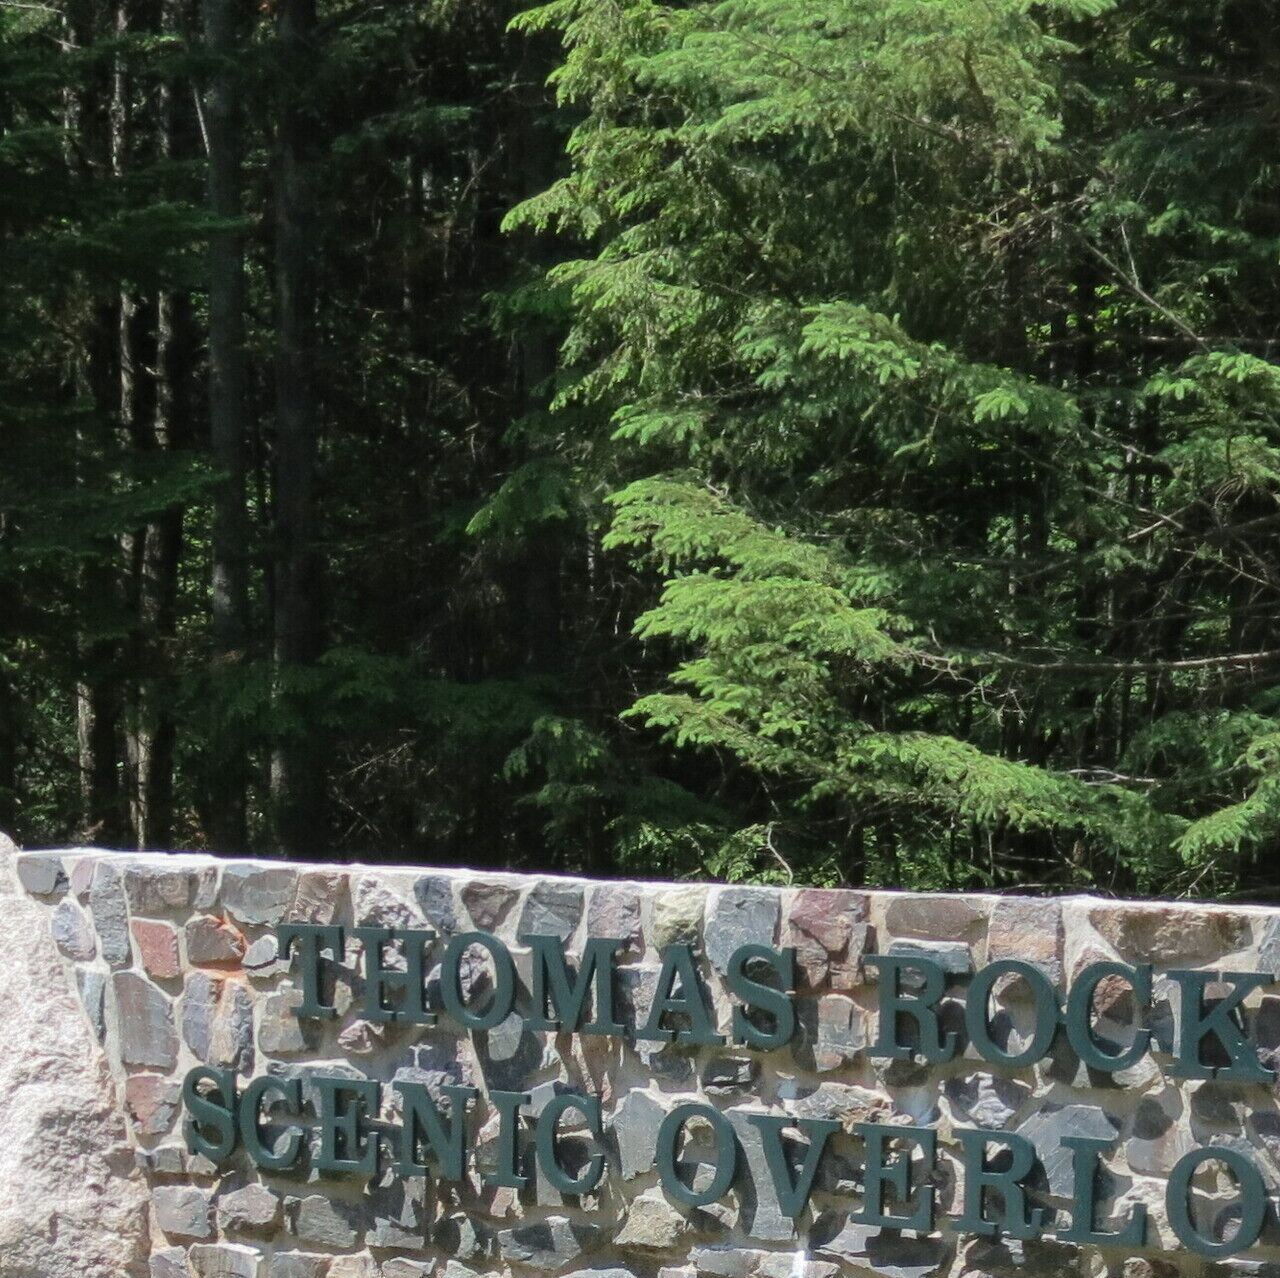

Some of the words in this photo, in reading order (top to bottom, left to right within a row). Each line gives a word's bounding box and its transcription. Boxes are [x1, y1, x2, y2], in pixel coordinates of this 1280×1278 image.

[278, 922, 798, 1051] THOMAS
[864, 952, 1277, 1082] ROCK
[182, 1066, 606, 1195] SCENIC
